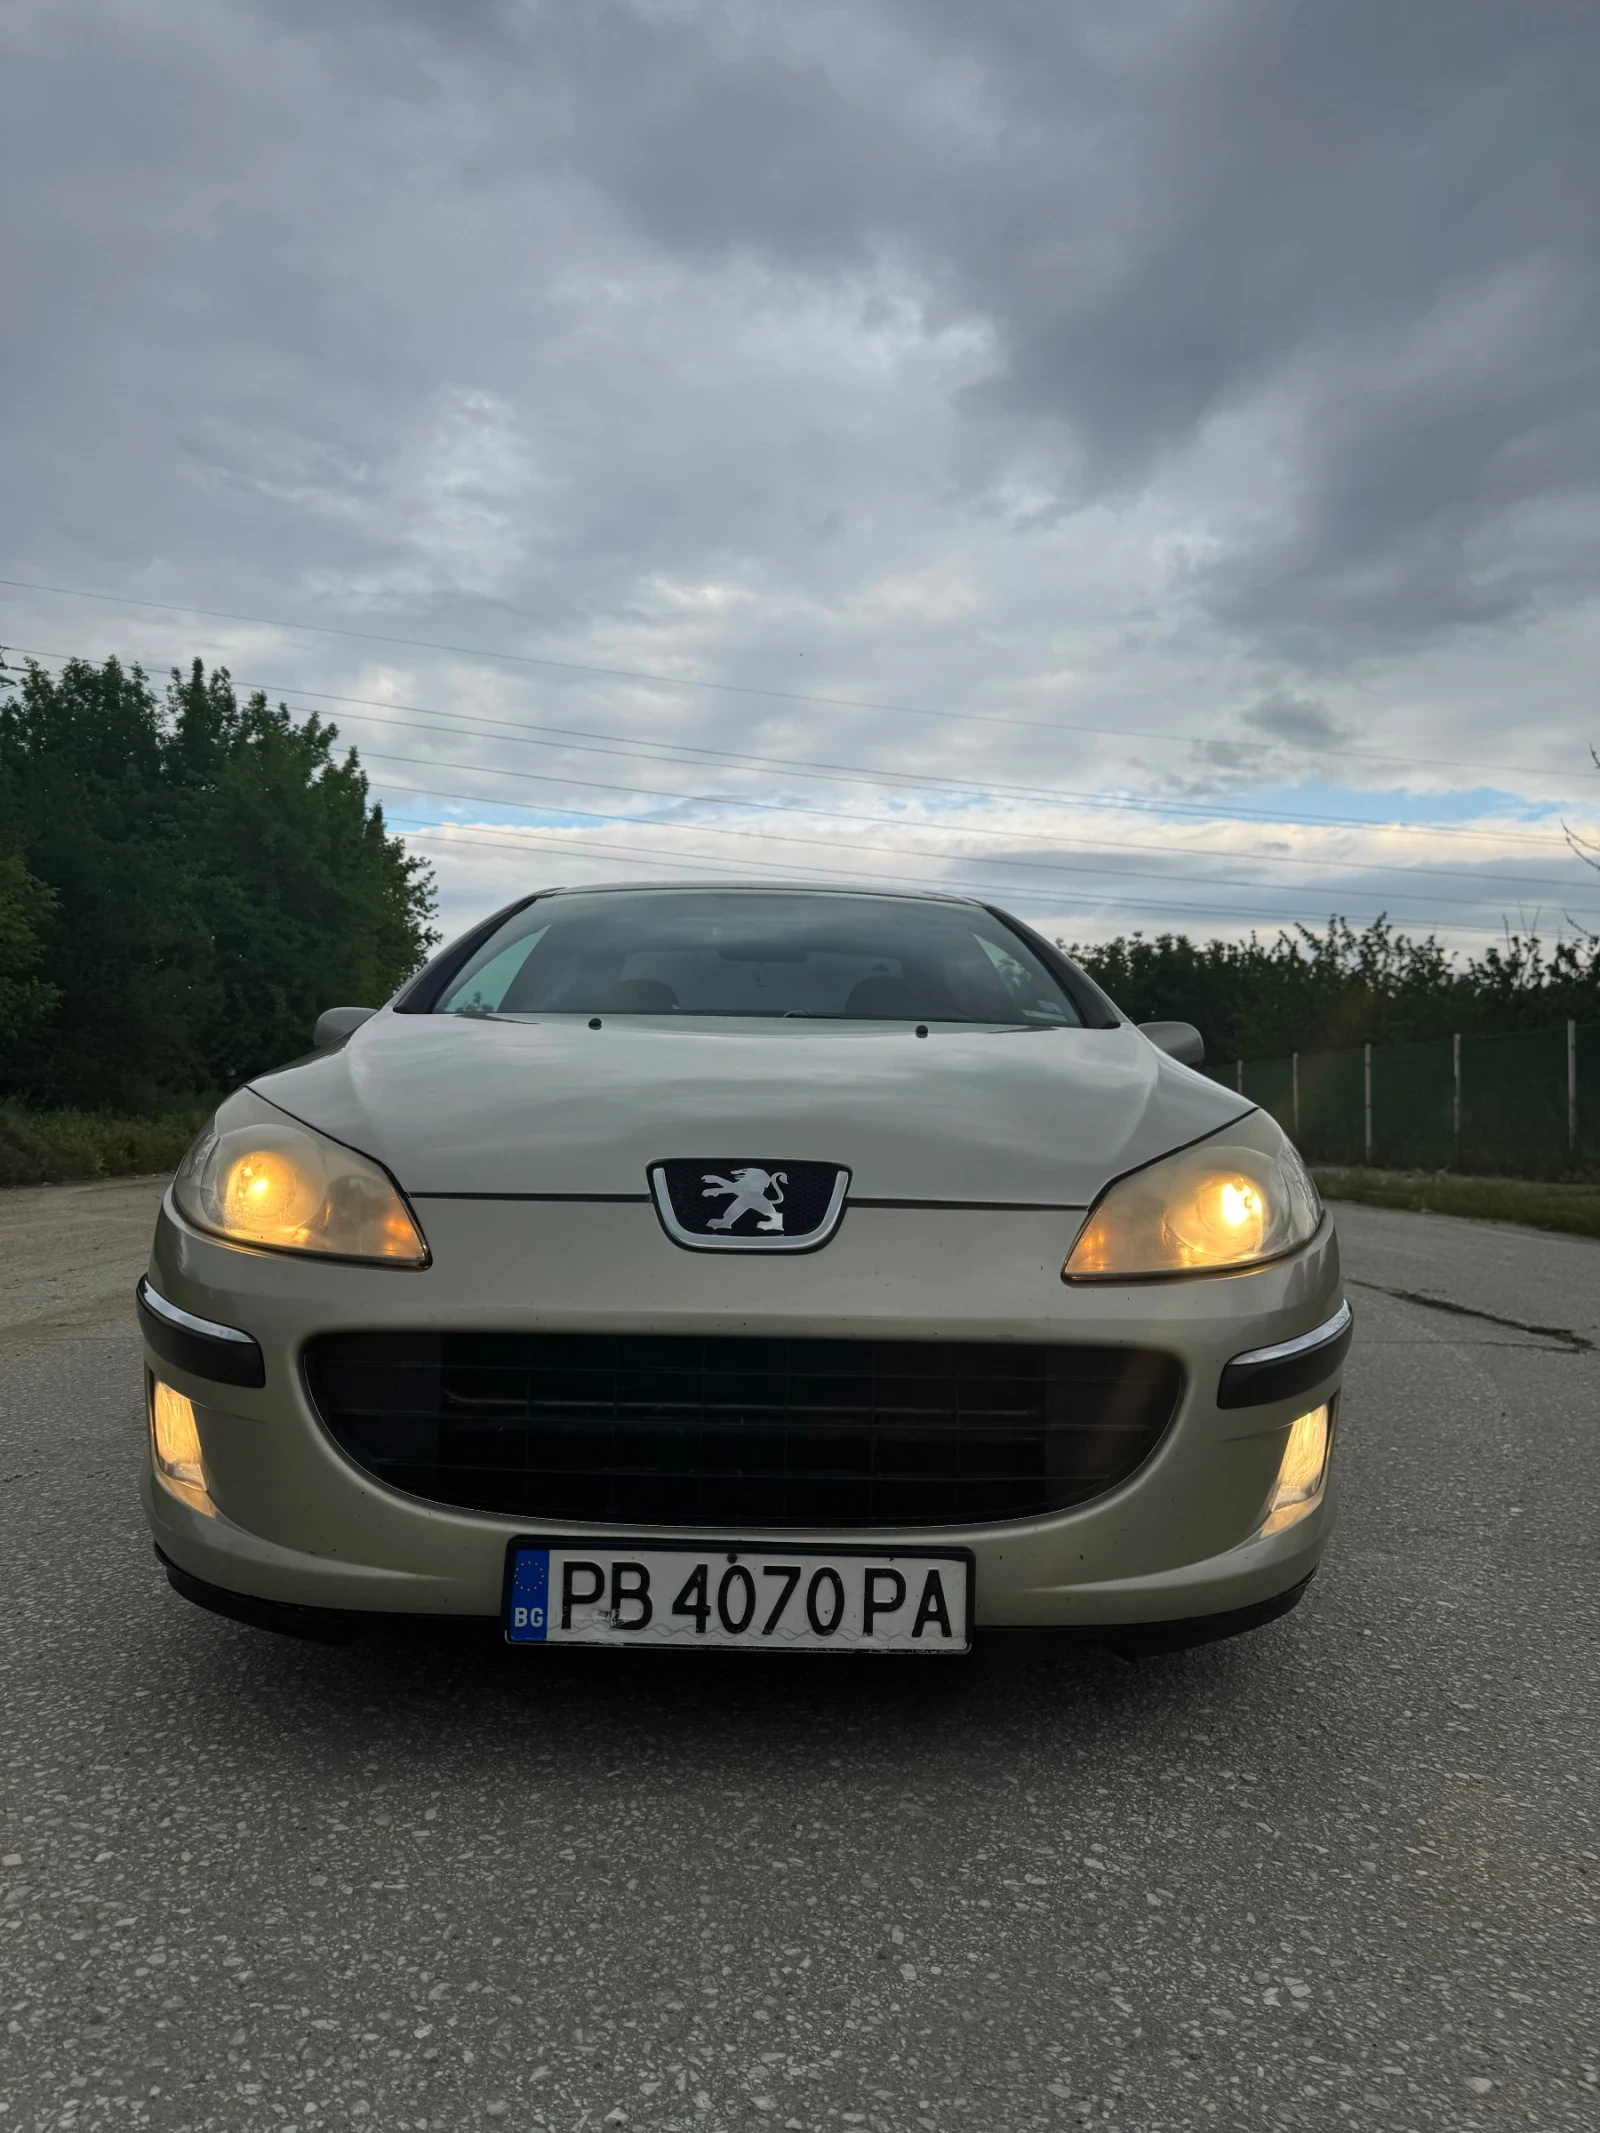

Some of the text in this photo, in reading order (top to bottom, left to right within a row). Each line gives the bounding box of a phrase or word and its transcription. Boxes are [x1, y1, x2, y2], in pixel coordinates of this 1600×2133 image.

[514, 1607, 544, 1628] BG
[560, 1560, 953, 1638] PB 4070 PA
